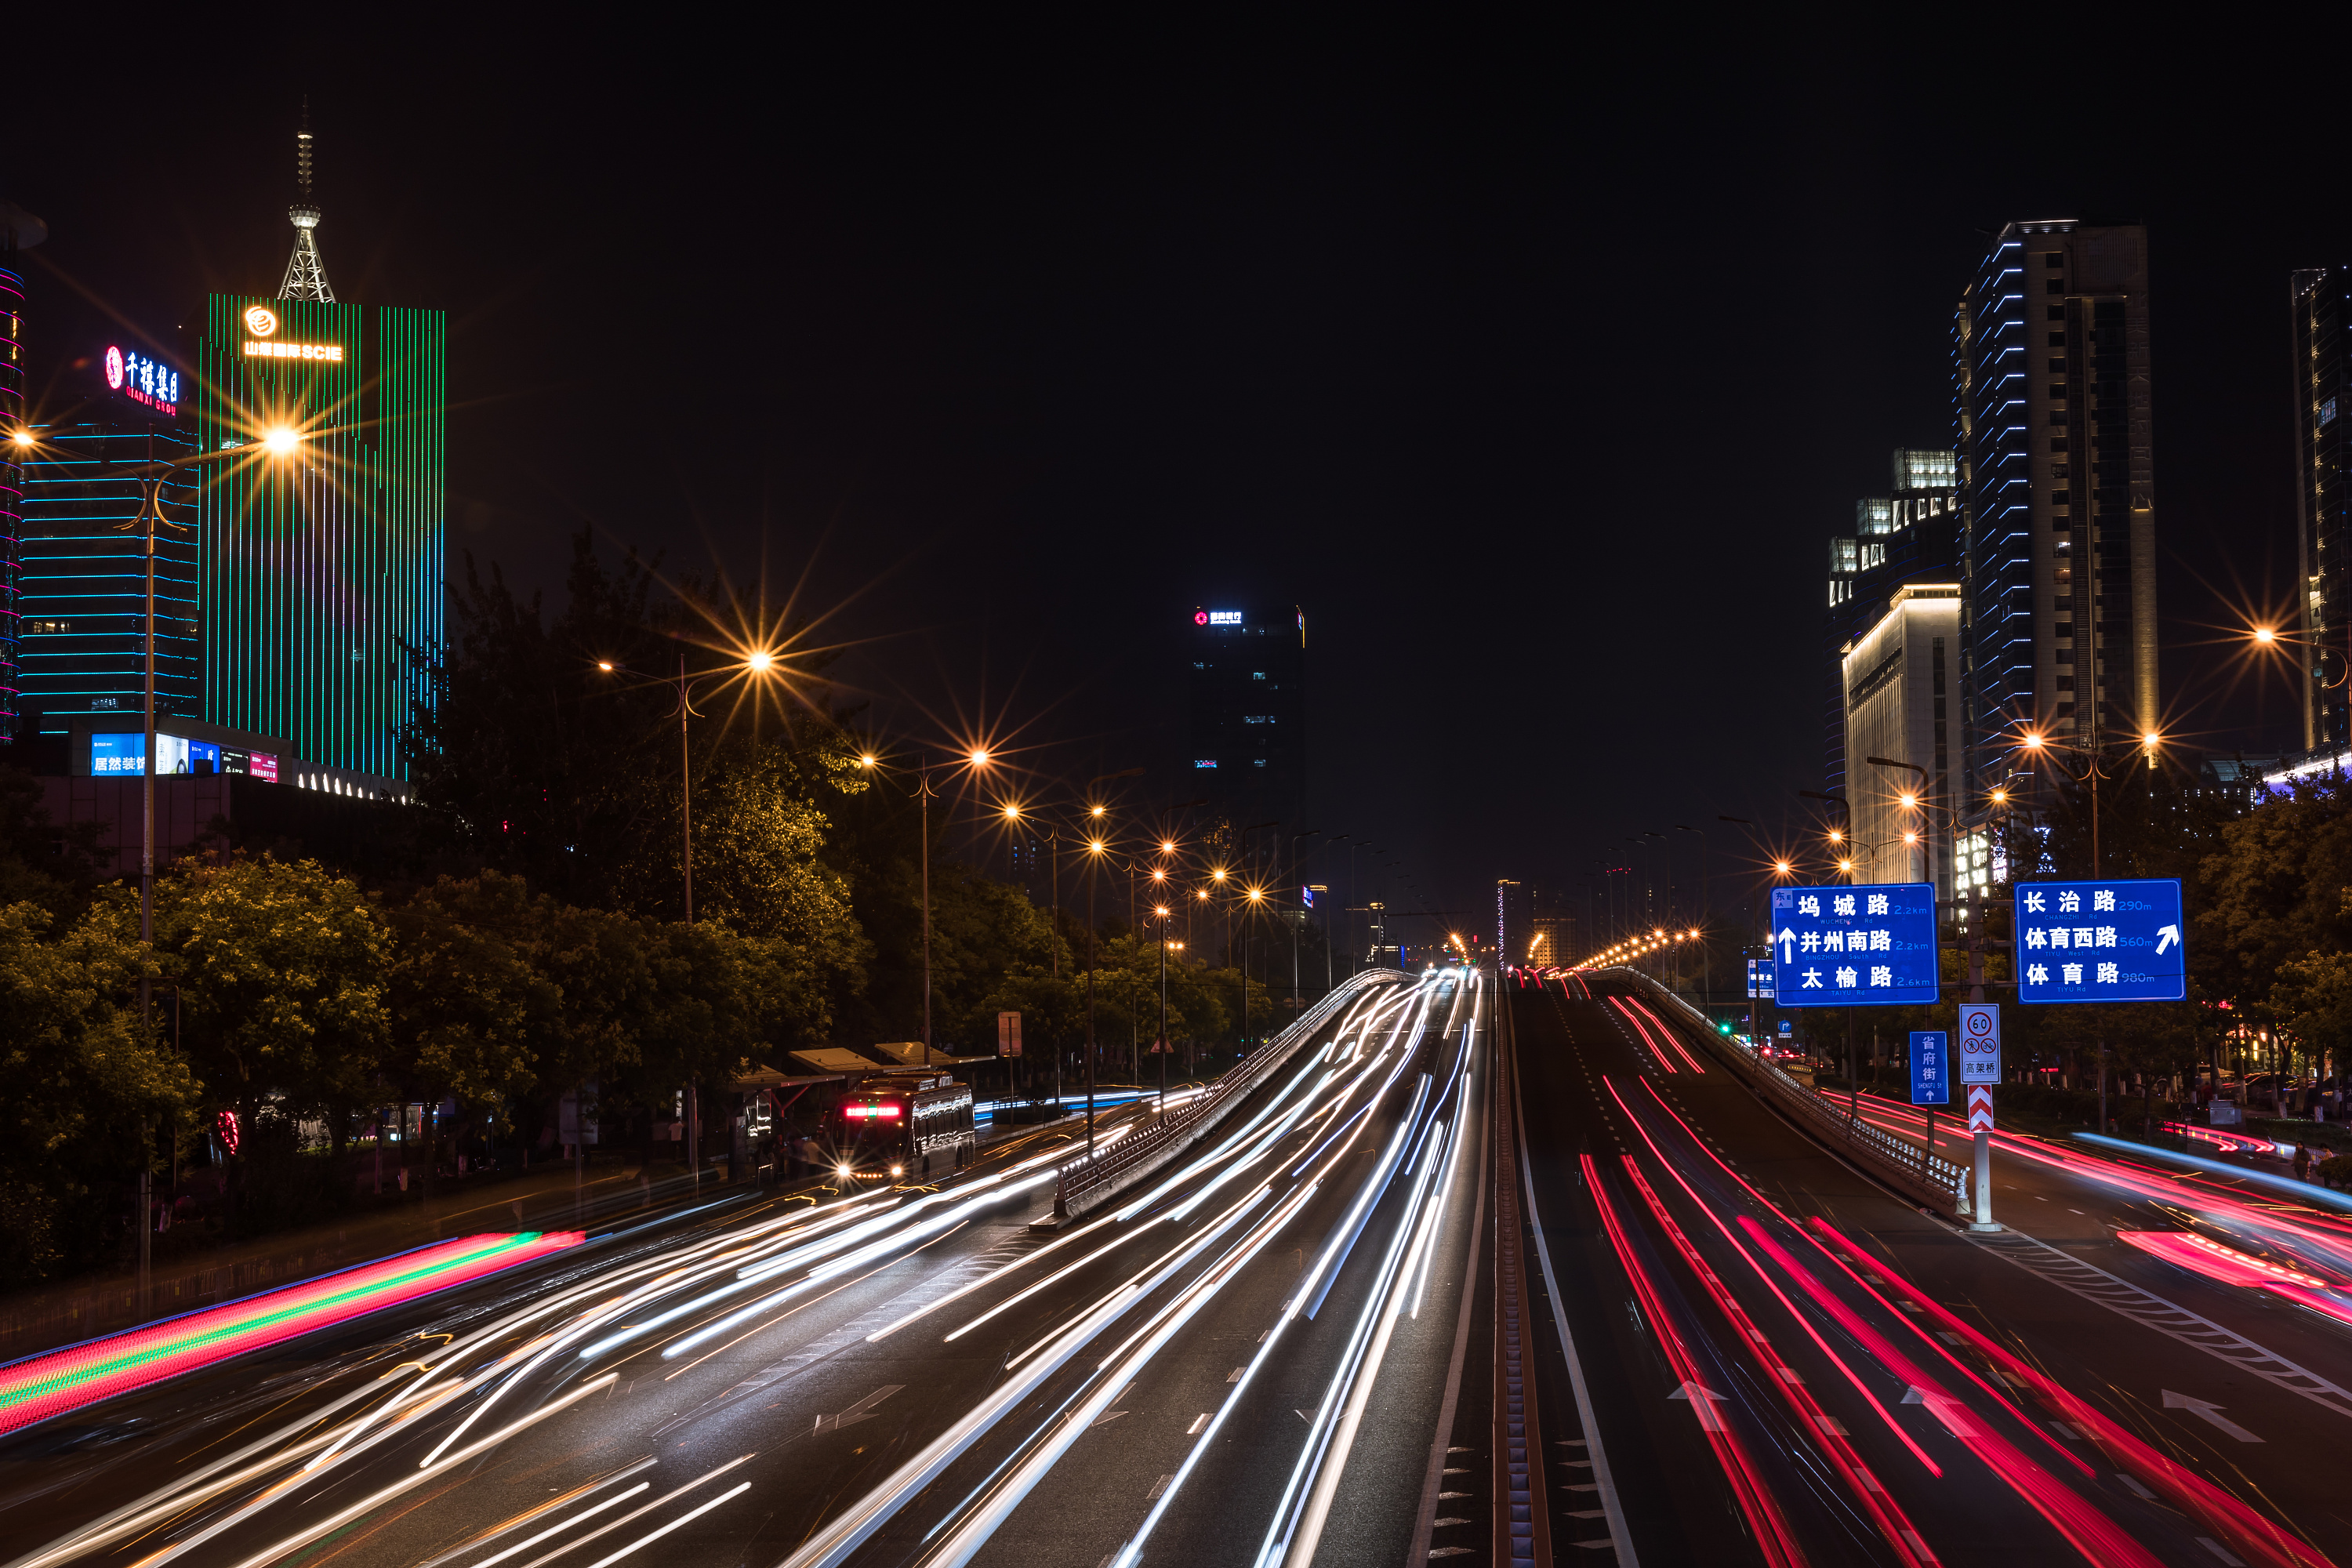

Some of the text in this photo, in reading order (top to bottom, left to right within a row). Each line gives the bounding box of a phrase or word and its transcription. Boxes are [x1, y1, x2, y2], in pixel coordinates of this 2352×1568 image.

[126, 385, 152, 406] QIANXI
[1776, 891, 1784, 902] 东
[1798, 893, 1927, 916] 坞城路 2.2km
[2023, 890, 2152, 913] 长治路 290m
[1800, 929, 1929, 953] 并州南路 2.2km
[2025, 925, 2153, 949] 体育西路 560m
[1801, 965, 1930, 989] 太榆路 2.6km
[2026, 961, 2155, 985] 体育路 980m
[1973, 1018, 1987, 1029] 60
[1922, 1036, 1936, 1081] 省府街
[1965, 1062, 1995, 1074] 高架桥
